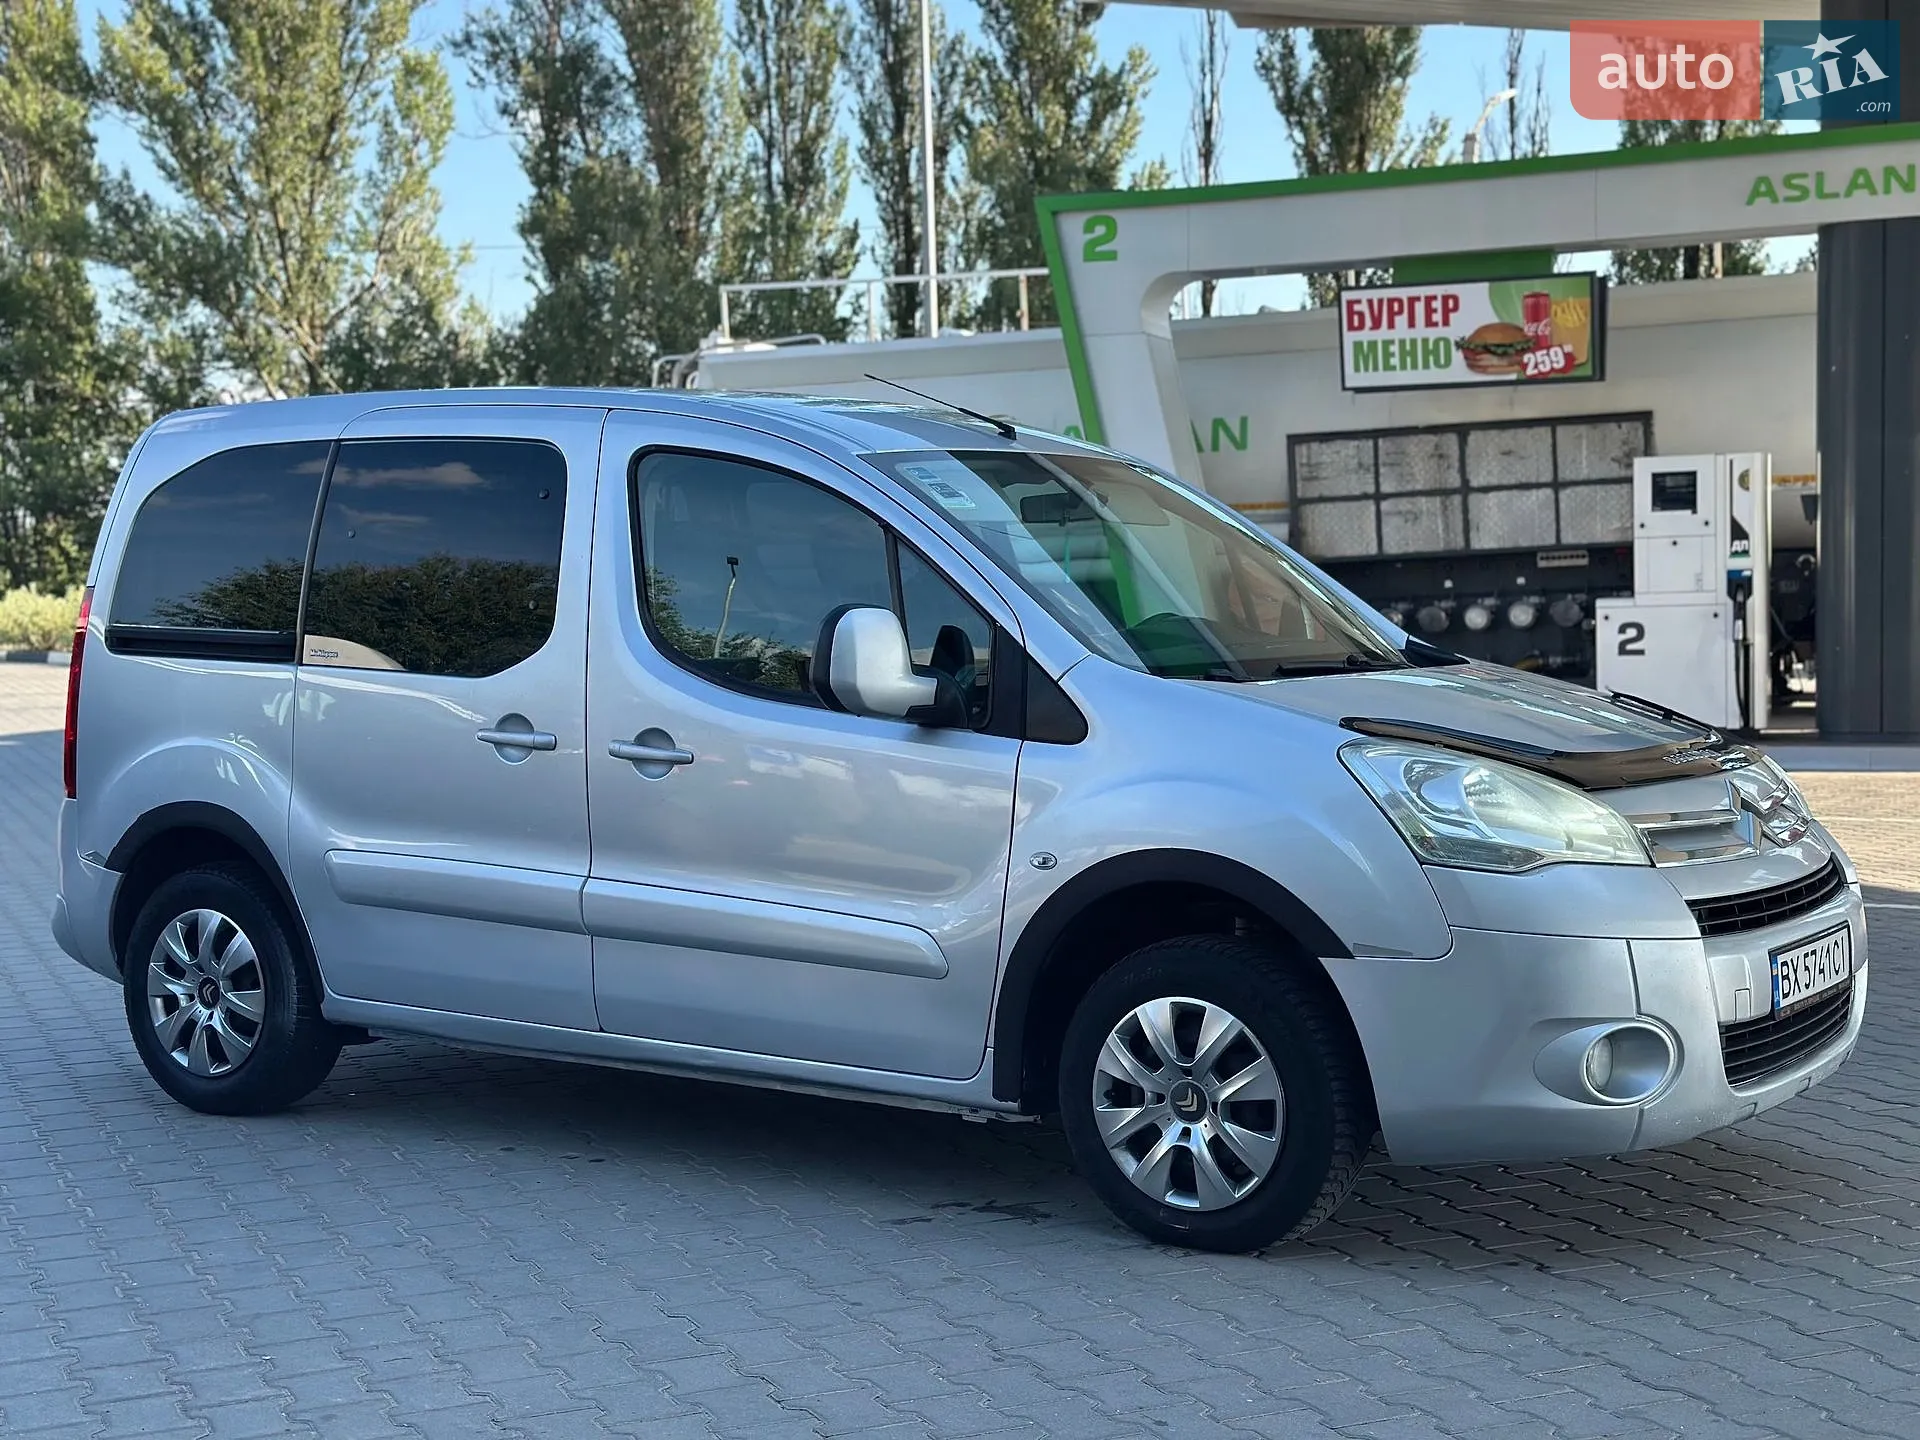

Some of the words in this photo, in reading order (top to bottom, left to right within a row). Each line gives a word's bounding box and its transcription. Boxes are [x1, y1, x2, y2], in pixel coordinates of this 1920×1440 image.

[1745, 163, 1916, 206] ASLAN
[1083, 214, 1118, 263] 2
[1346, 294, 1461, 332] БУРГЕР
[1352, 336, 1453, 373] МЕНЮ
[1617, 622, 1646, 656] 2
